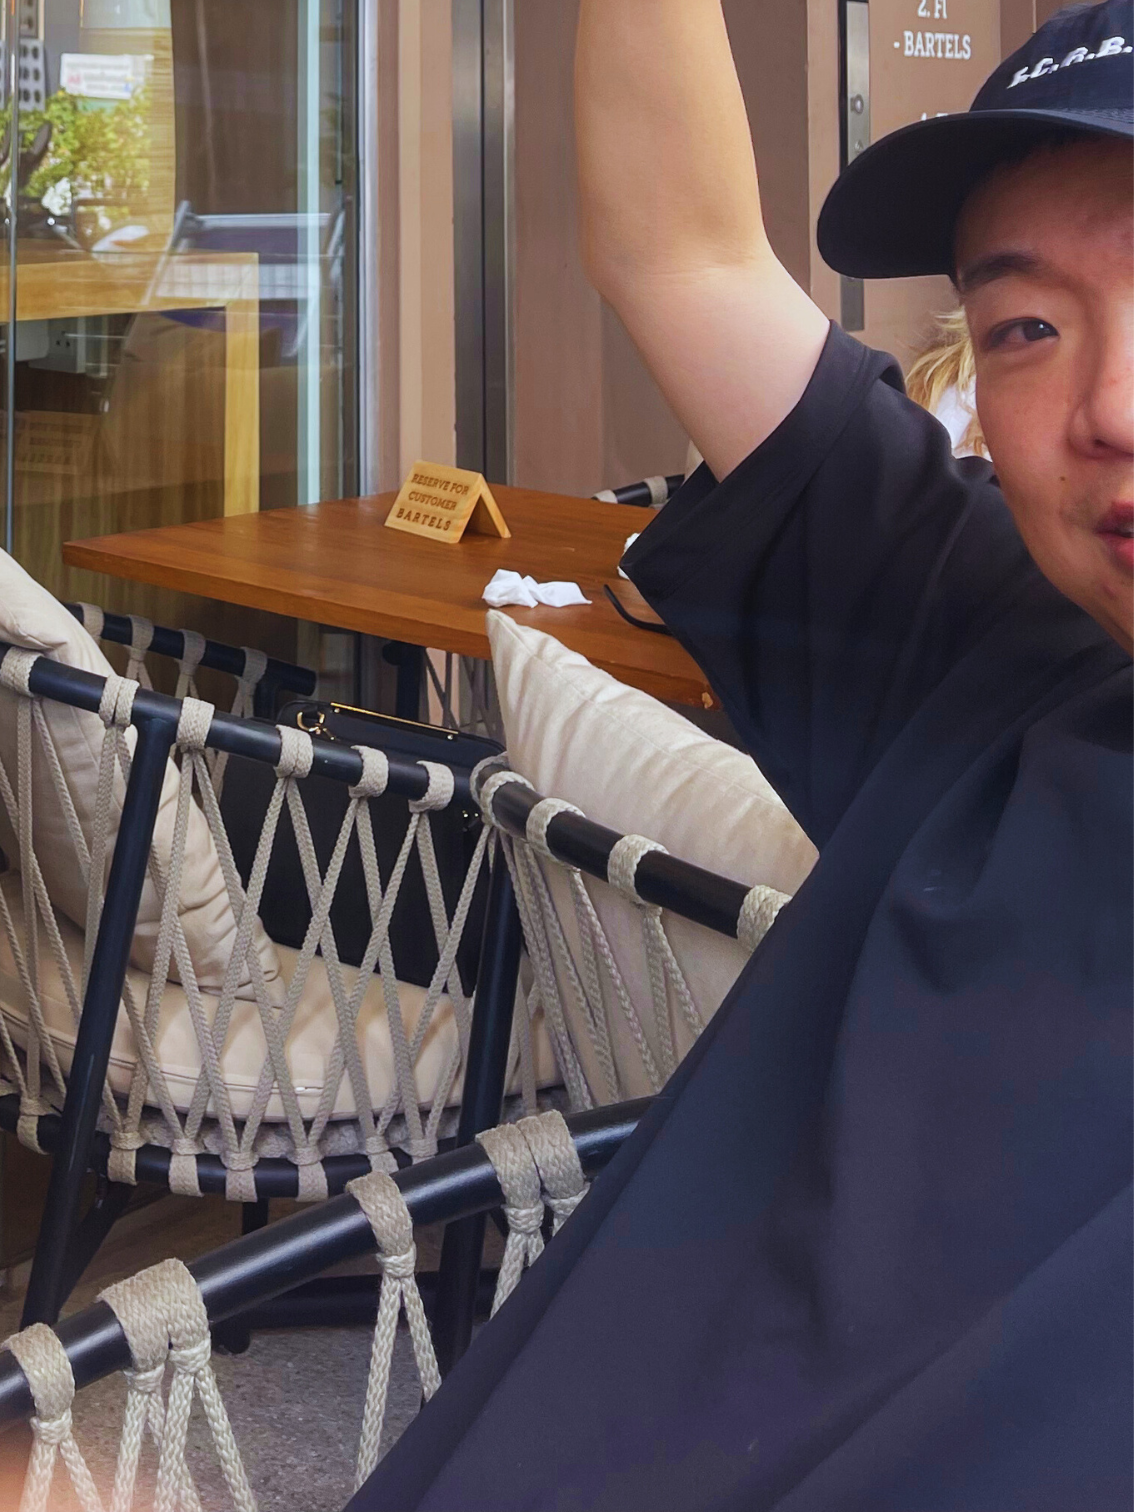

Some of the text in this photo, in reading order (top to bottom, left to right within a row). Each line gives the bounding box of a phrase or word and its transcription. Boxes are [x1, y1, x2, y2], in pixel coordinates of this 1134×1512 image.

[903, 30, 972, 60] BARTELS
[411, 473, 470, 495] RESERVE FOR
[408, 491, 458, 511] CUSTOMER
[396, 508, 452, 531] BARTELS
